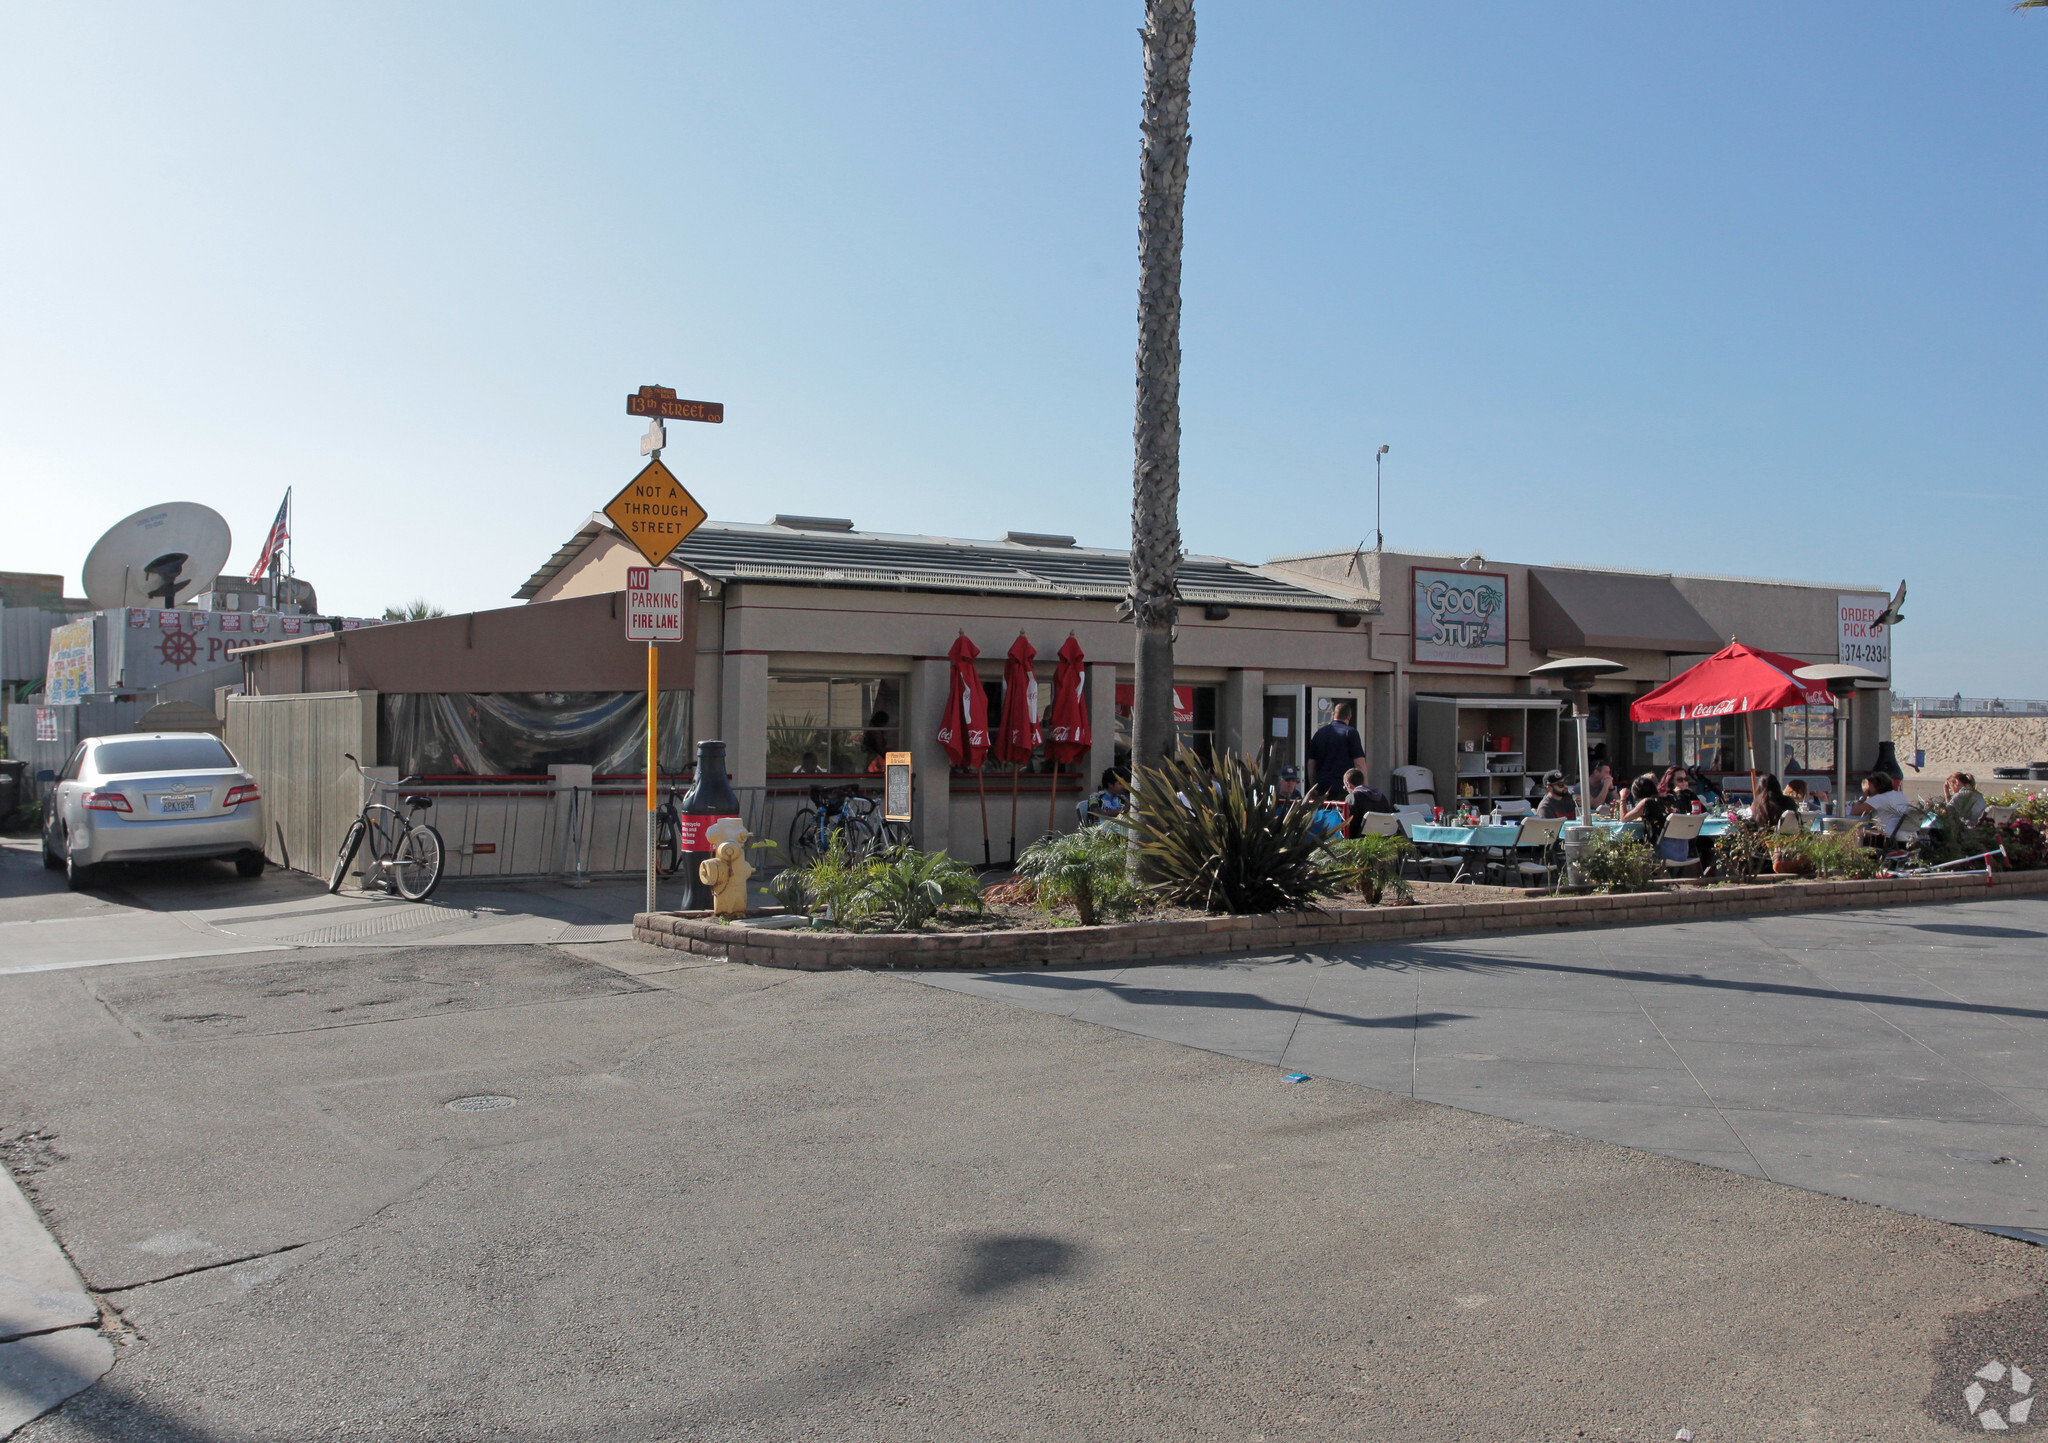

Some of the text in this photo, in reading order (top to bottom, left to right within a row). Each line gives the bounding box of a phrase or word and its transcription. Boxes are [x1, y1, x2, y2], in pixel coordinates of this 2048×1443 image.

[631, 398, 657, 413] 13th
[661, 401, 704, 418] STREET
[636, 485, 677, 498] NOT A
[624, 502, 688, 517] THROUGH
[632, 521, 681, 534] STREET
[630, 570, 646, 588] NO
[632, 592, 678, 609] PARKING
[1426, 580, 1494, 618] GOOD
[633, 614, 679, 629] FIRE LANE
[1841, 607, 1875, 621] ORDER
[1431, 612, 1490, 649] STUFF
[1844, 623, 1883, 638] PICK UP
[1845, 644, 1887, 662] 374-2334
[1691, 698, 1738, 718] Coca-Cola
